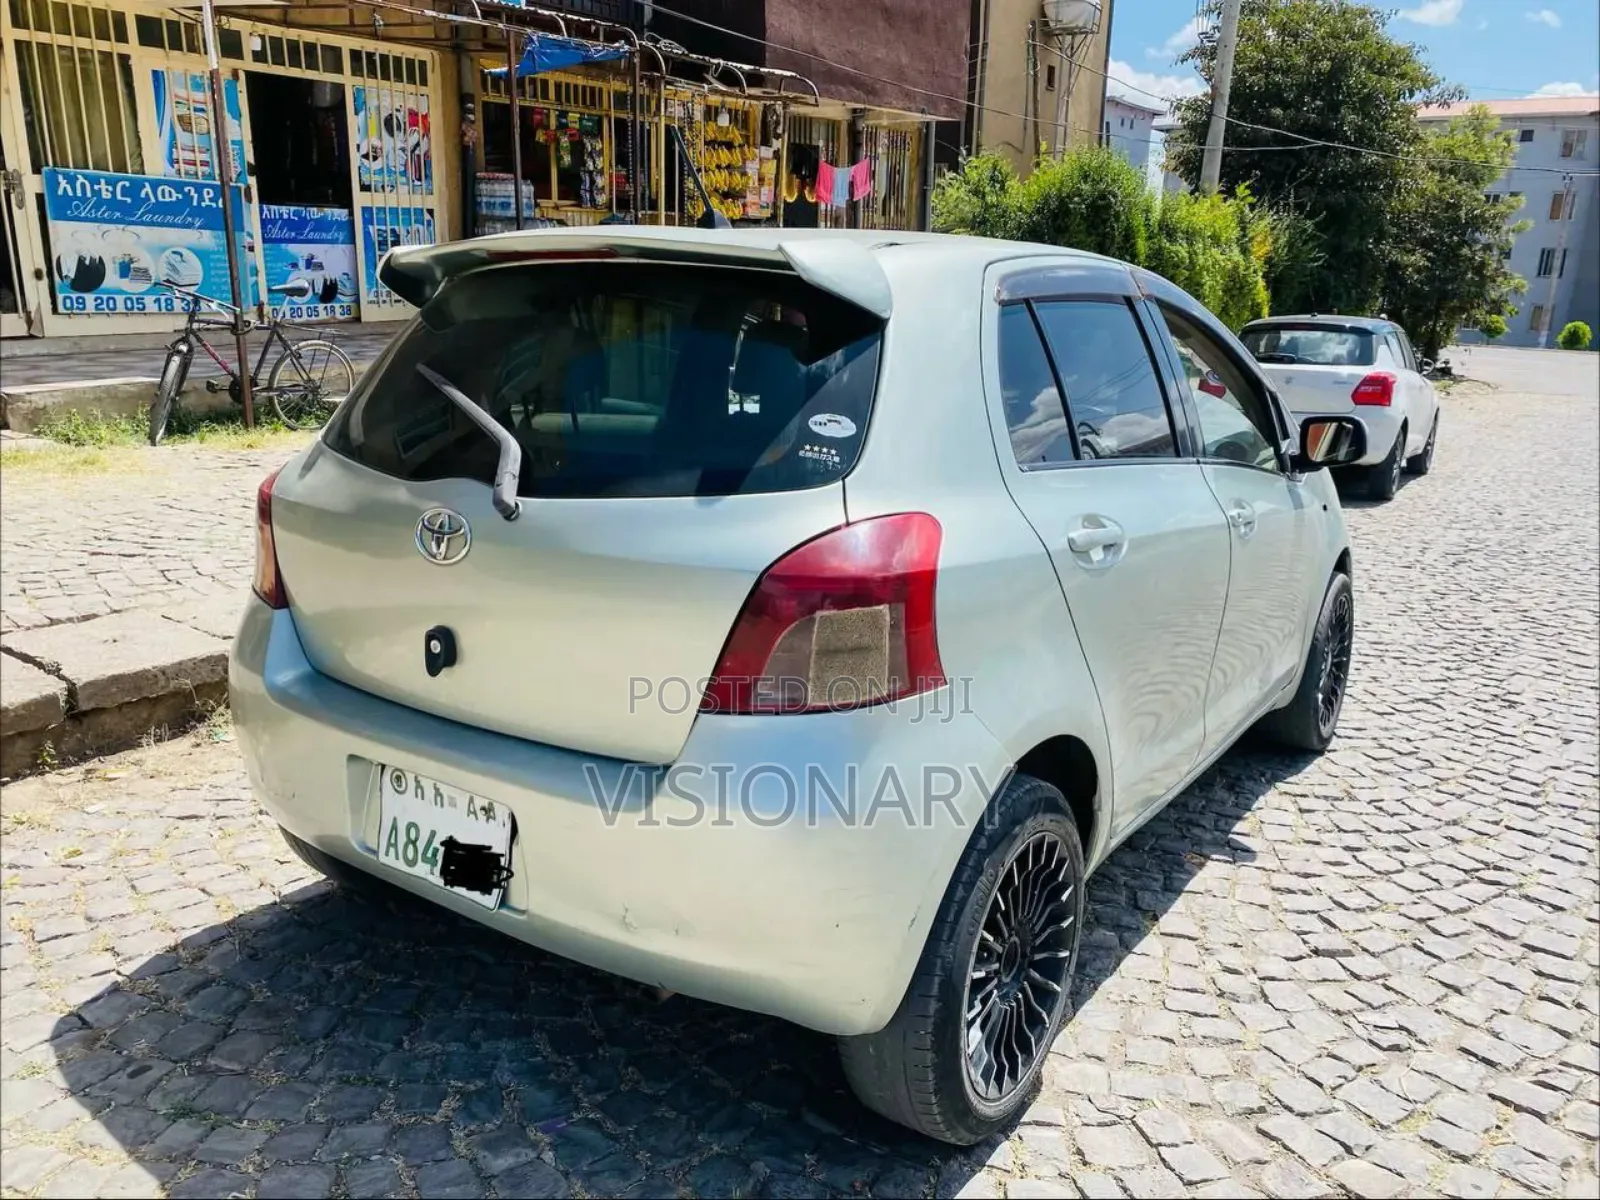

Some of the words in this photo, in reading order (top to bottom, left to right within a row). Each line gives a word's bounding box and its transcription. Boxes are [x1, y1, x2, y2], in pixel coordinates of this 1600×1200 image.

[57, 173, 132, 204] አስቴር
[66, 197, 122, 220] Aster
[125, 202, 205, 230] Laundry
[264, 220, 296, 239] Aster
[297, 220, 347, 243] Laundry
[62, 295, 87, 312] 09
[94, 295, 117, 312] 20
[124, 295, 146, 312] 05
[153, 296, 175, 312] 18
[289, 306, 303, 318] 20
[306, 305, 320, 317] 05
[339, 304, 352, 316] 38
